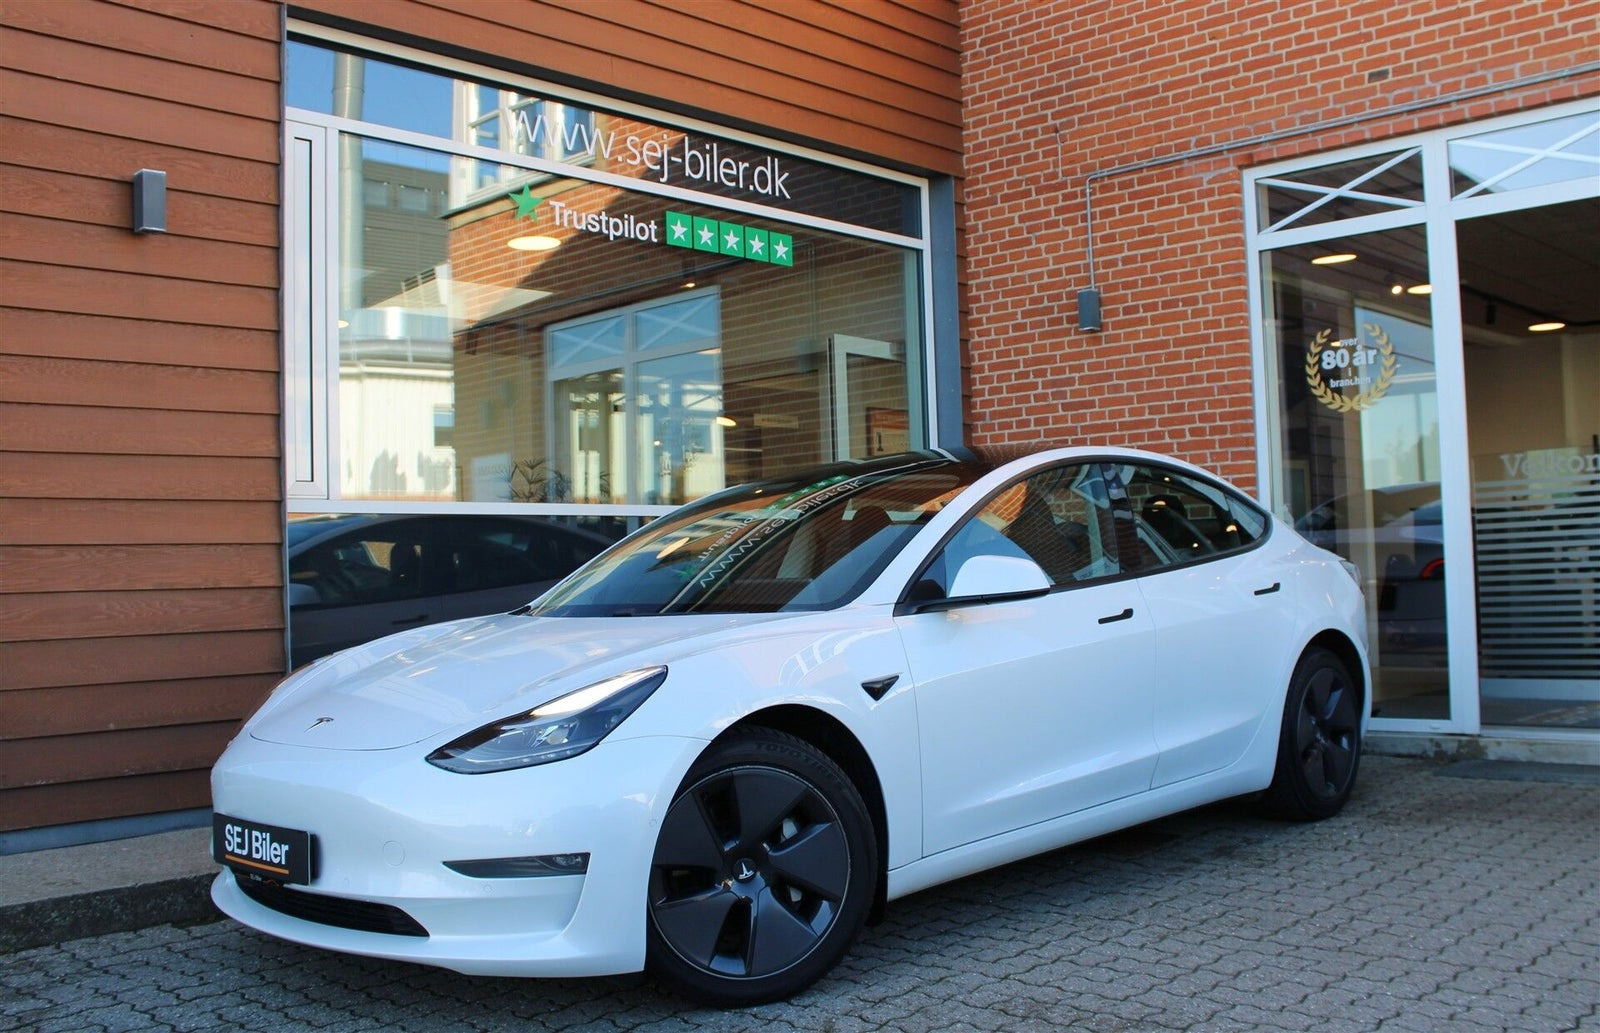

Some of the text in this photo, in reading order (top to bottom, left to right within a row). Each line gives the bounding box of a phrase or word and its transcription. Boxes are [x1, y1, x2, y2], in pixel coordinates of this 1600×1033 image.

[504, 107, 791, 199] www.sej-biler.dk
[549, 201, 658, 243] Trustpilot
[1321, 344, 1377, 370] 80 år
[1338, 337, 1359, 347] over
[225, 823, 290, 865] SEJ Biler
